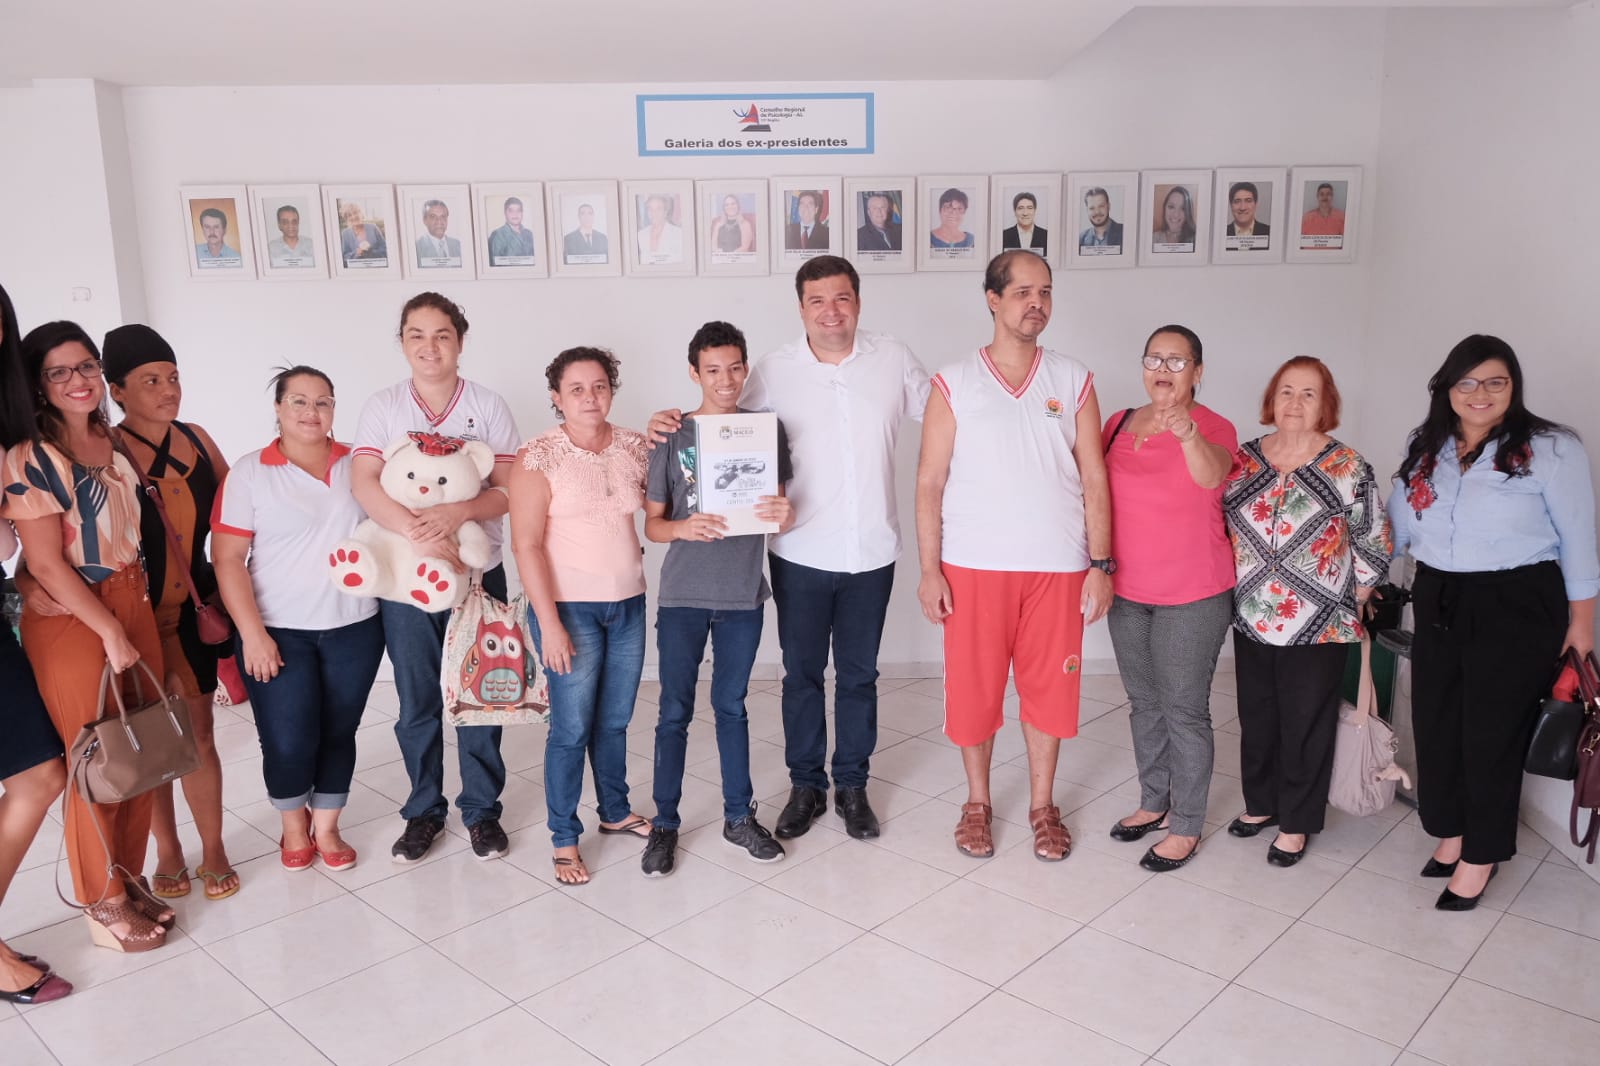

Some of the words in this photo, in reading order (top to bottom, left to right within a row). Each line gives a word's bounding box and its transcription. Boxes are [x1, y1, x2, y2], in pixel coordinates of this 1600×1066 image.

[784, 106, 806, 114] Regional
[664, 138, 714, 148] Galeria
[718, 138, 742, 148] dos
[746, 137, 848, 149] ex-presidentes
